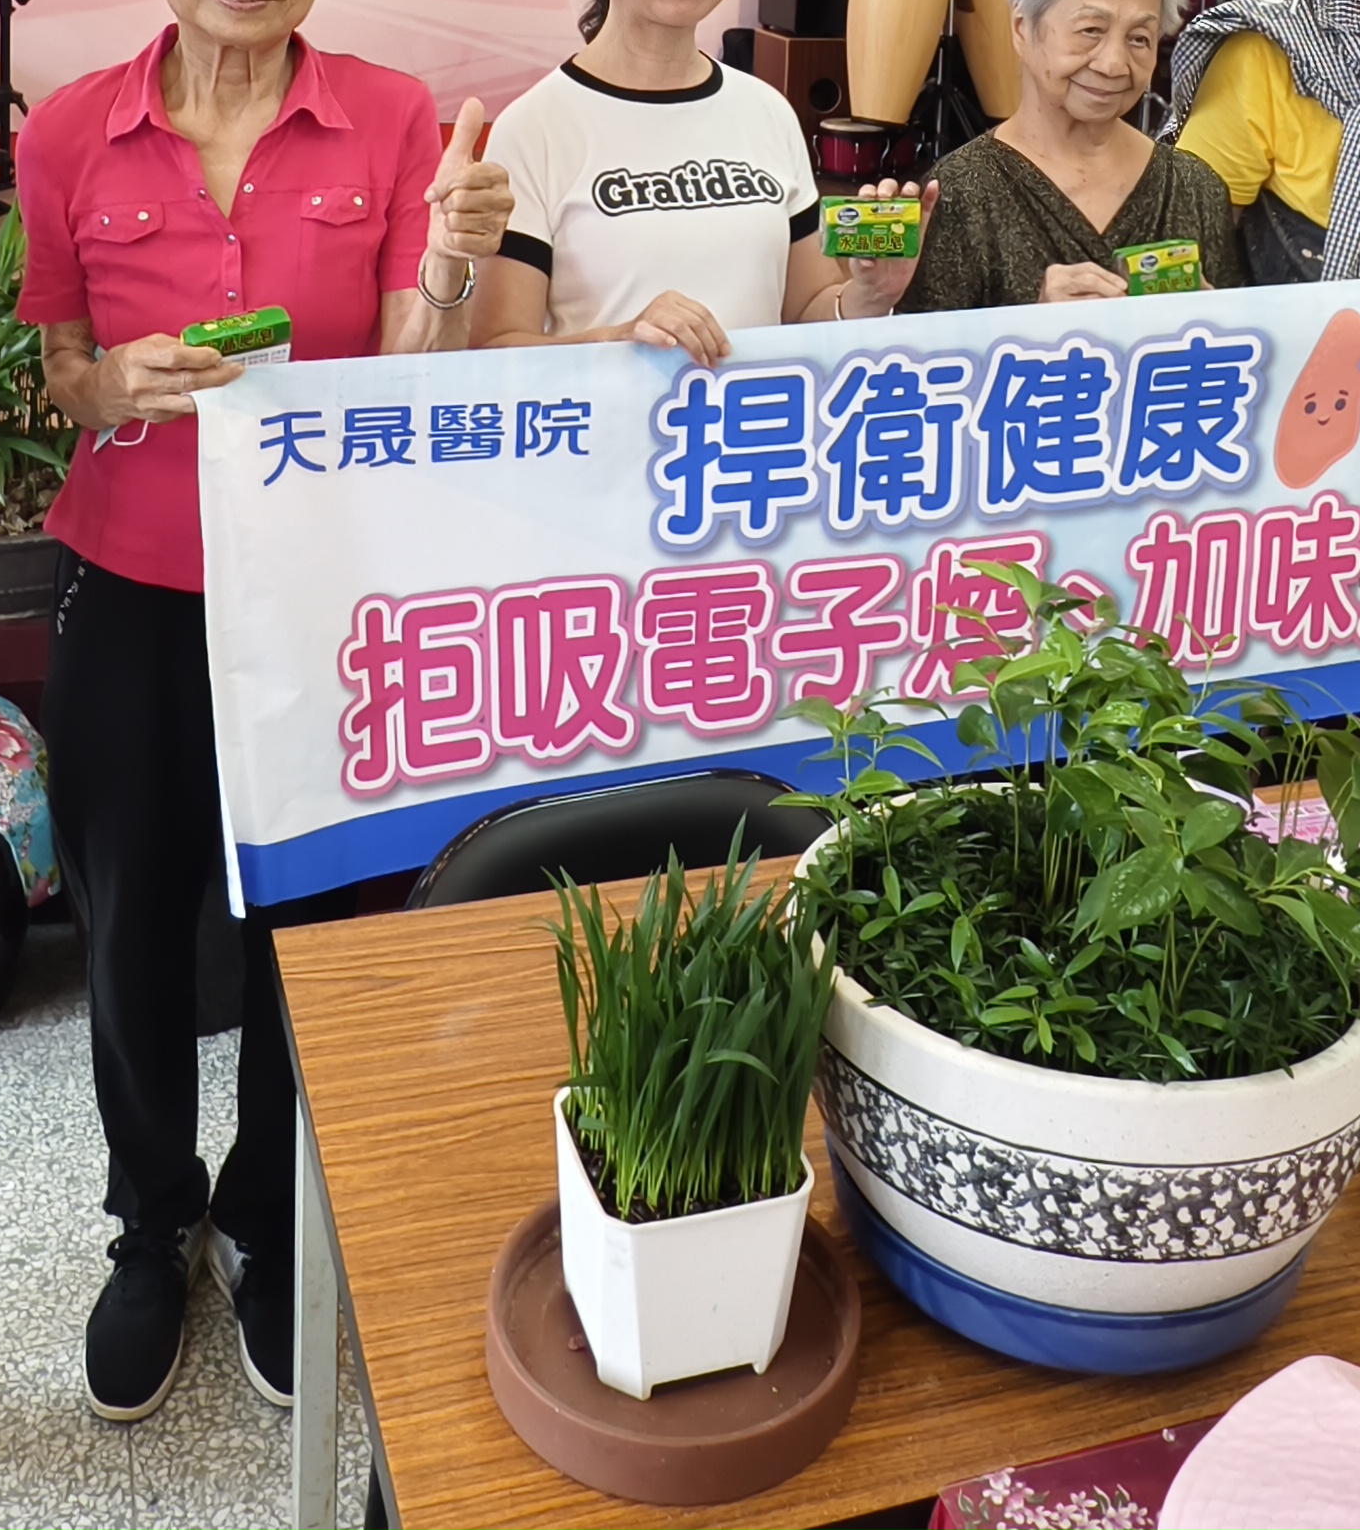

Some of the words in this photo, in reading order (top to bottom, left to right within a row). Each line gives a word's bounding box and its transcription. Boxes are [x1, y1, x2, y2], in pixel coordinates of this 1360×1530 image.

[592, 159, 784, 216] Gratidão
[839, 234, 905, 252] 水晶肥皂
[258, 396, 593, 488] 天晟醫院
[658, 330, 1264, 542] 捍衛健康
